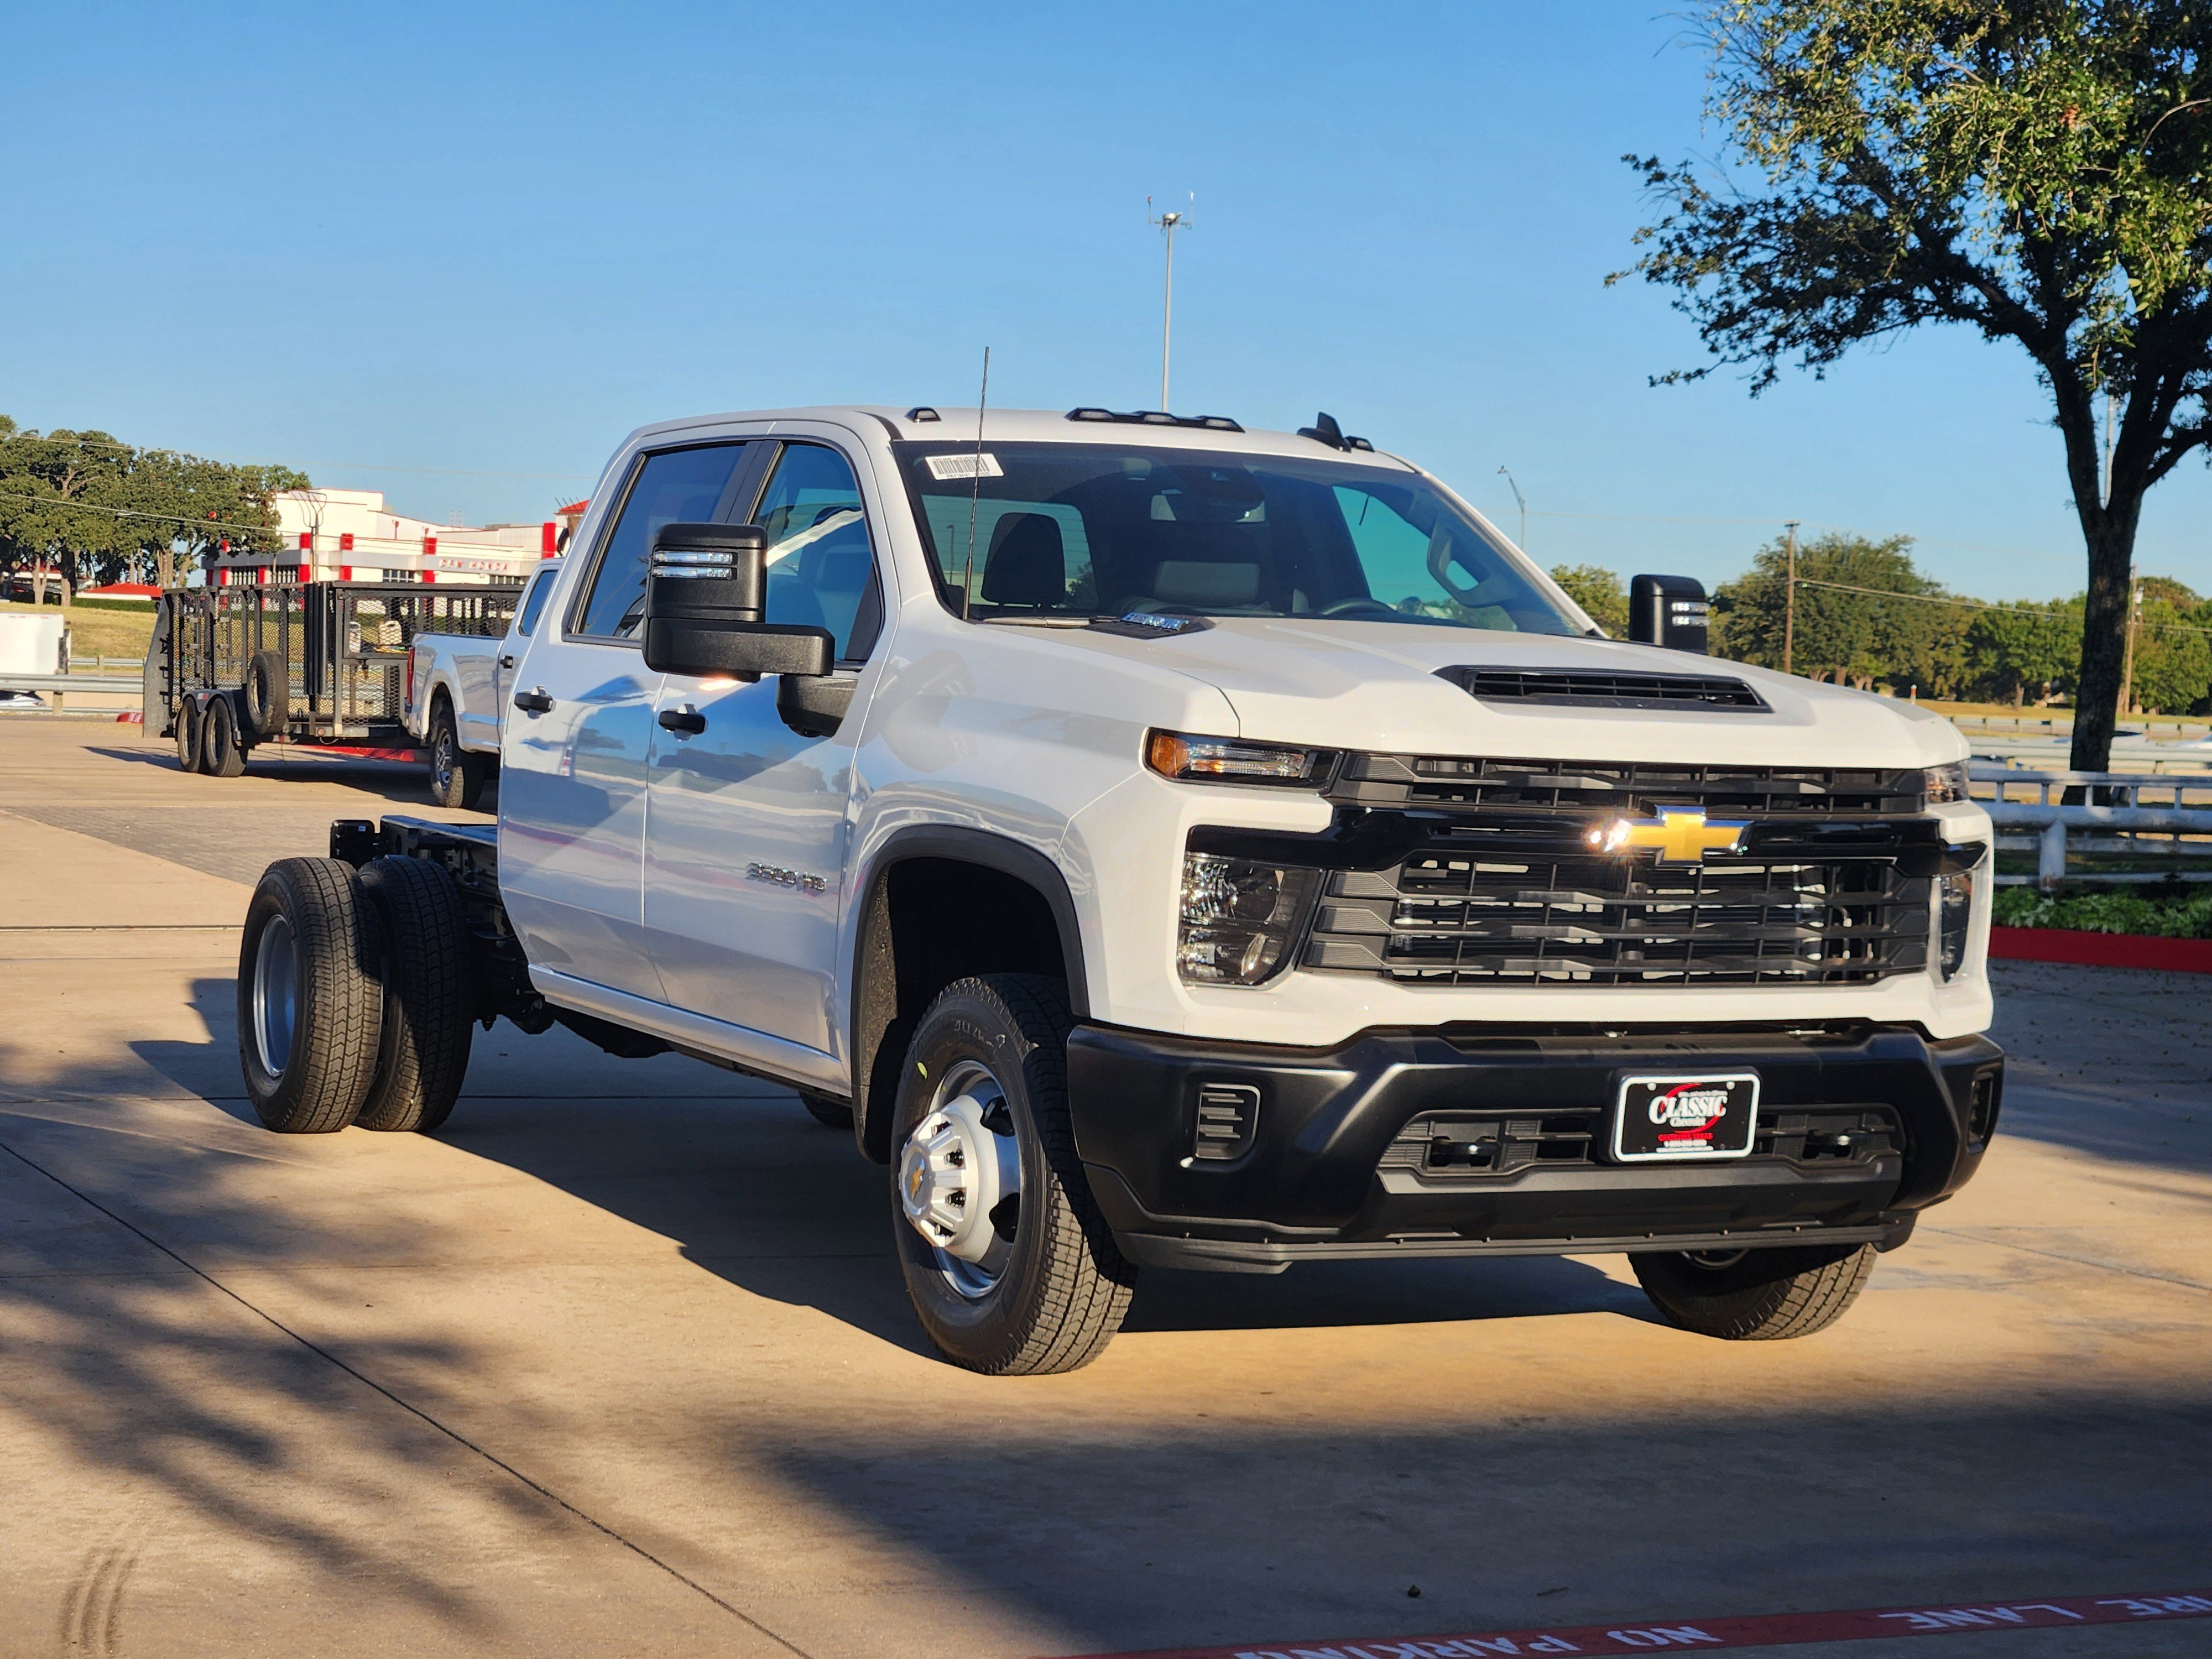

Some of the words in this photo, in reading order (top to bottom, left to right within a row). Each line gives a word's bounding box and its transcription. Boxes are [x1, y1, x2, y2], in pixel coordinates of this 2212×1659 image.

[439, 559, 463, 568] DFW
[469, 561, 508, 571] HONDA
[802, 872, 828, 891] HD
[1649, 1095, 1728, 1124] CLASSIC
[2095, 1595, 2212, 1616] IRE
[1878, 1604, 2084, 1629] LANE
[1606, 1626, 1724, 1646] NO
